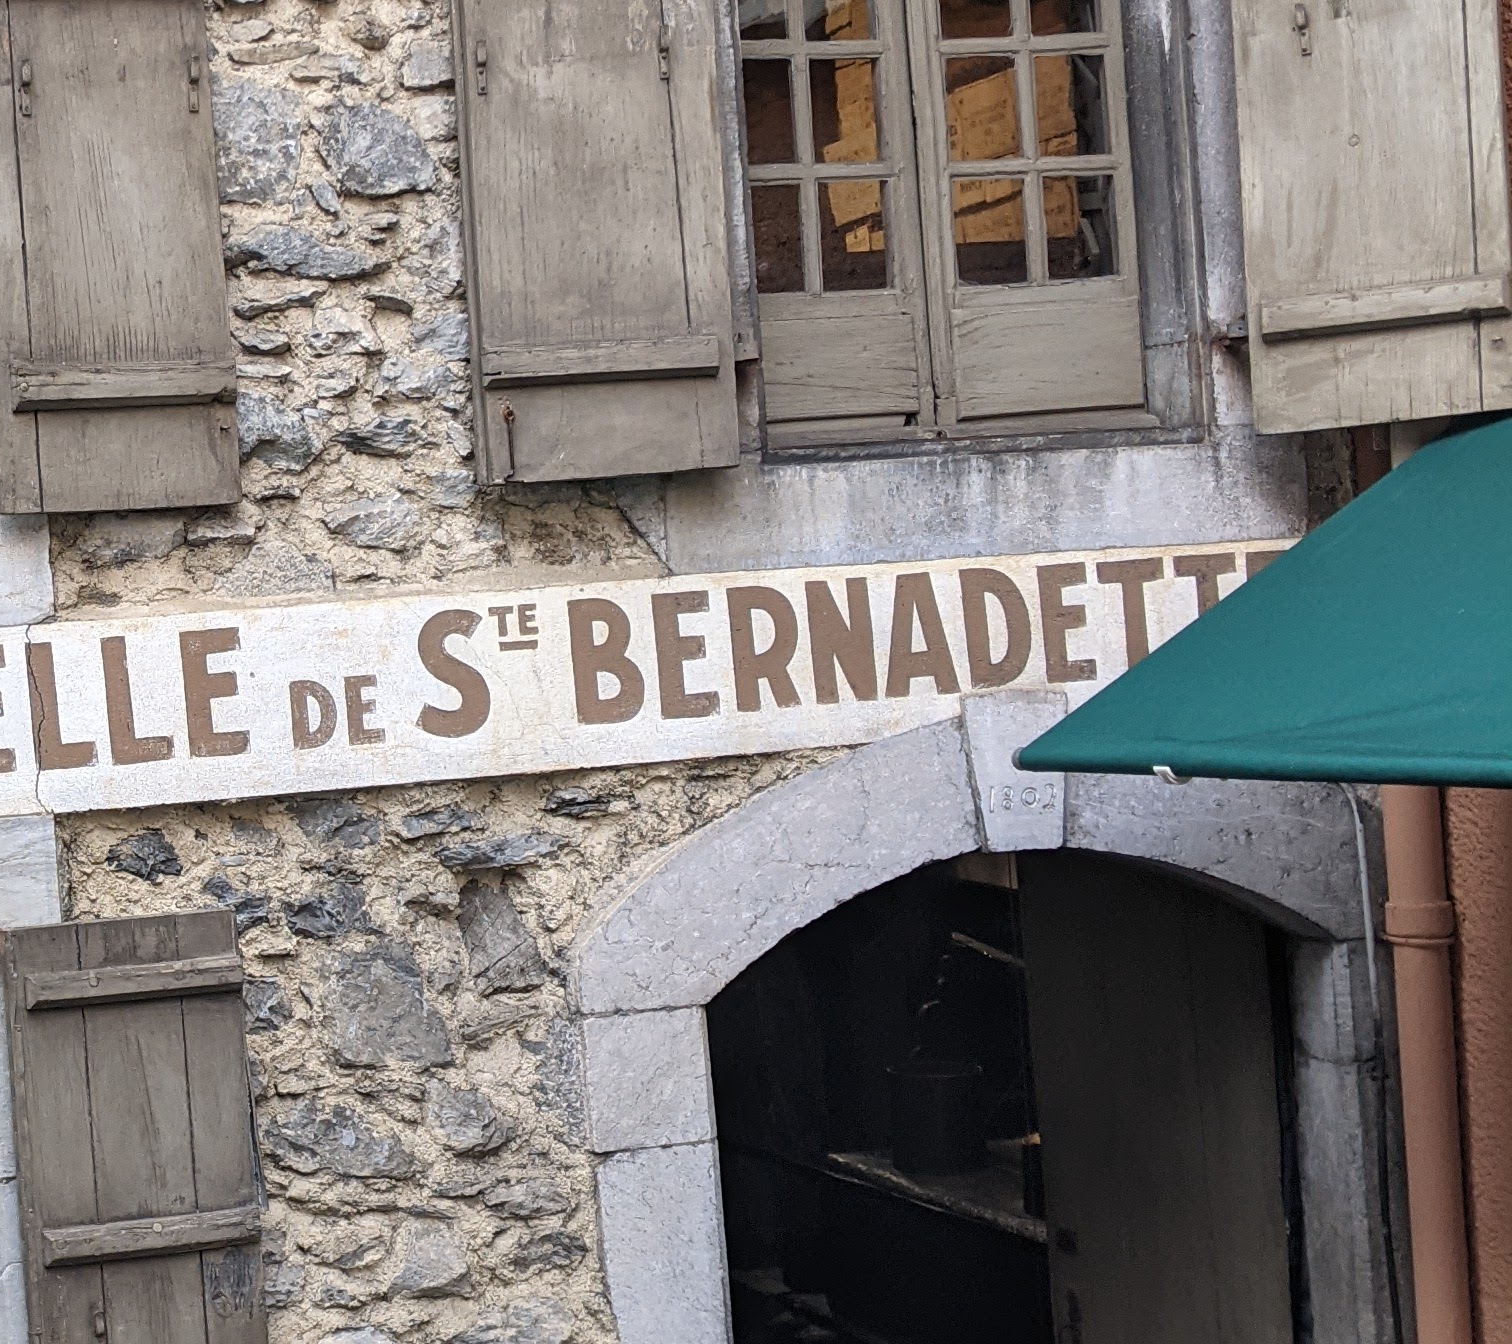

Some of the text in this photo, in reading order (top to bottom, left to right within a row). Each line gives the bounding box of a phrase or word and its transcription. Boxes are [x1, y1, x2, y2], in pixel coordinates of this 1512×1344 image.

[289, 674, 386, 750] DE
[567, 550, 1286, 725] BERNADETT
[989, 783, 1057, 814] 1802
